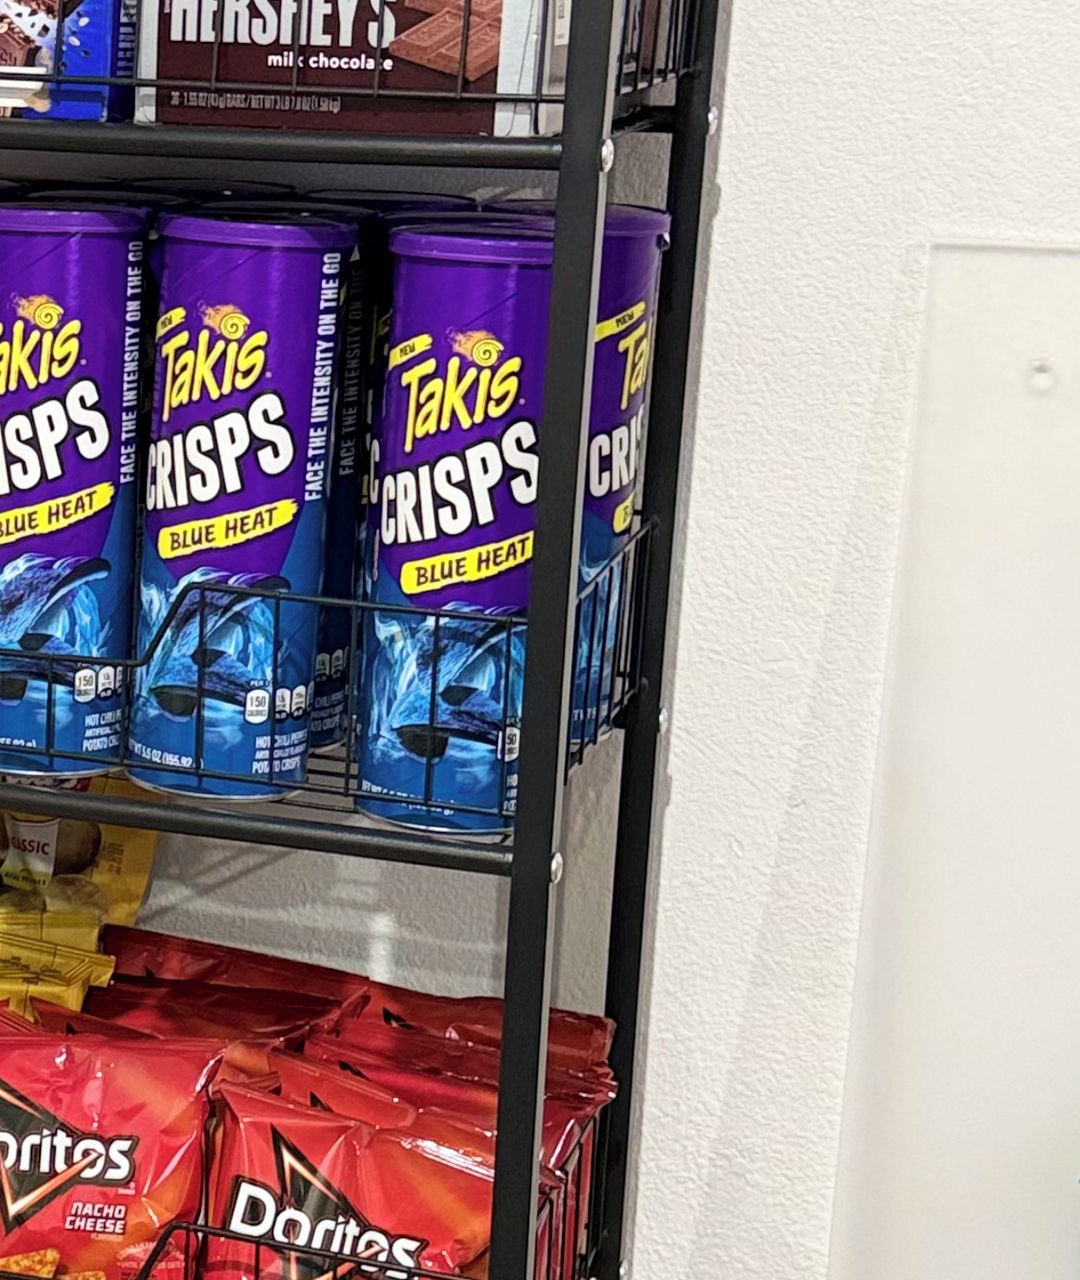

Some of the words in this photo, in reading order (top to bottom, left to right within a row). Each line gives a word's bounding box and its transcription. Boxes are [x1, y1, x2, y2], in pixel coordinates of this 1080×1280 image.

[128, 240, 143, 262] GO
[322, 252, 341, 273] GO
[127, 266, 143, 292] THE
[319, 278, 340, 310] THE
[125, 298, 142, 321] ON
[318, 314, 337, 337] ON
[399, 342, 416, 357] NEW
[122, 325, 141, 412] INTENSITY
[161, 328, 268, 422] Takis
[310, 340, 334, 419] INTENSITY
[400, 356, 522, 453] Takis
[122, 412, 139, 442] THE
[308, 425, 328, 459] THE
[121, 443, 137, 484] FACE
[146, 392, 294, 511] CRISPS
[304, 462, 323, 501] FACE
[381, 421, 540, 545] CRISPS
[47, 490, 98, 524] HEAT
[169, 523, 215, 551] BLUE
[224, 506, 278, 539] HEAT
[415, 558, 467, 586] BLUE
[477, 538, 530, 574] HEAT
[77, 675, 94, 688] 150
[249, 696, 266, 707] 150
[64, 1216, 126, 1233] CHEESE
[70, 1201, 127, 1218] NACHO
[227, 1180, 422, 1280] Doritos
